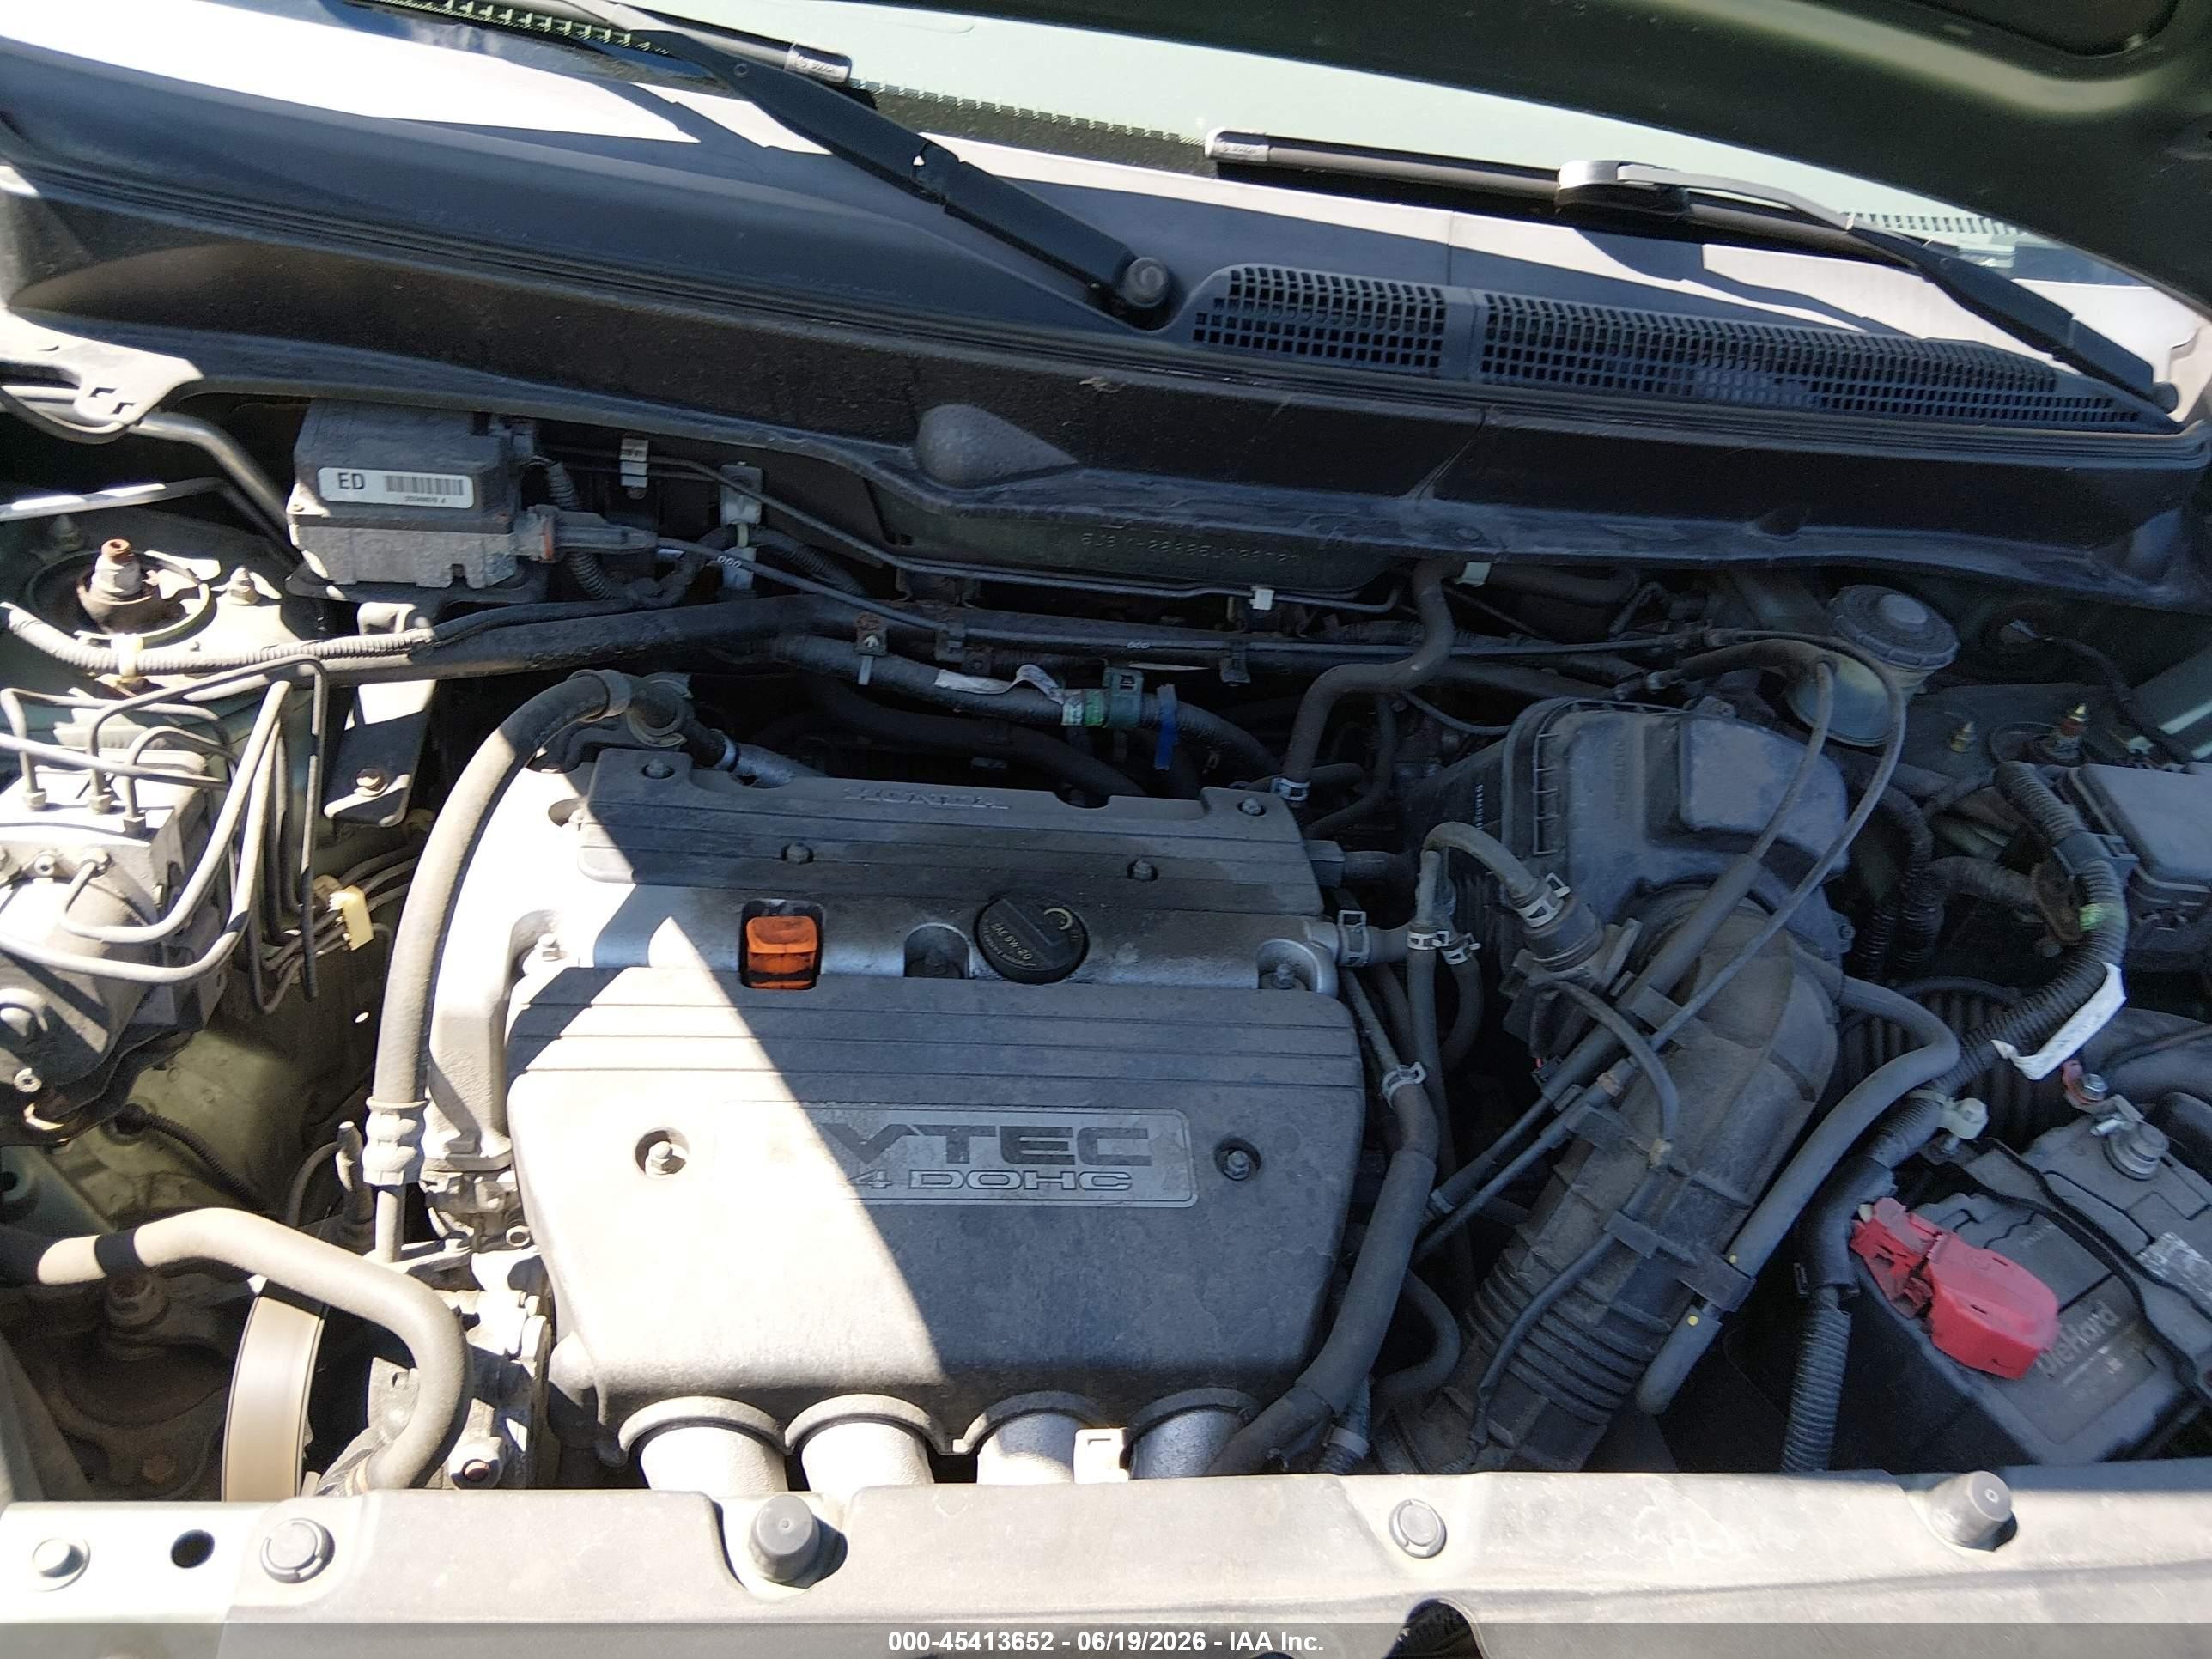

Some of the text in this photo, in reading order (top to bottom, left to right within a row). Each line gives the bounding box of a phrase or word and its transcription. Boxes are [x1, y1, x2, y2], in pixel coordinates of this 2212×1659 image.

[337, 472, 365, 489] ED
[844, 787, 1009, 810] HONDA
[819, 1123, 1152, 1166] VTEC
[908, 1169, 1133, 1191] DOHC
